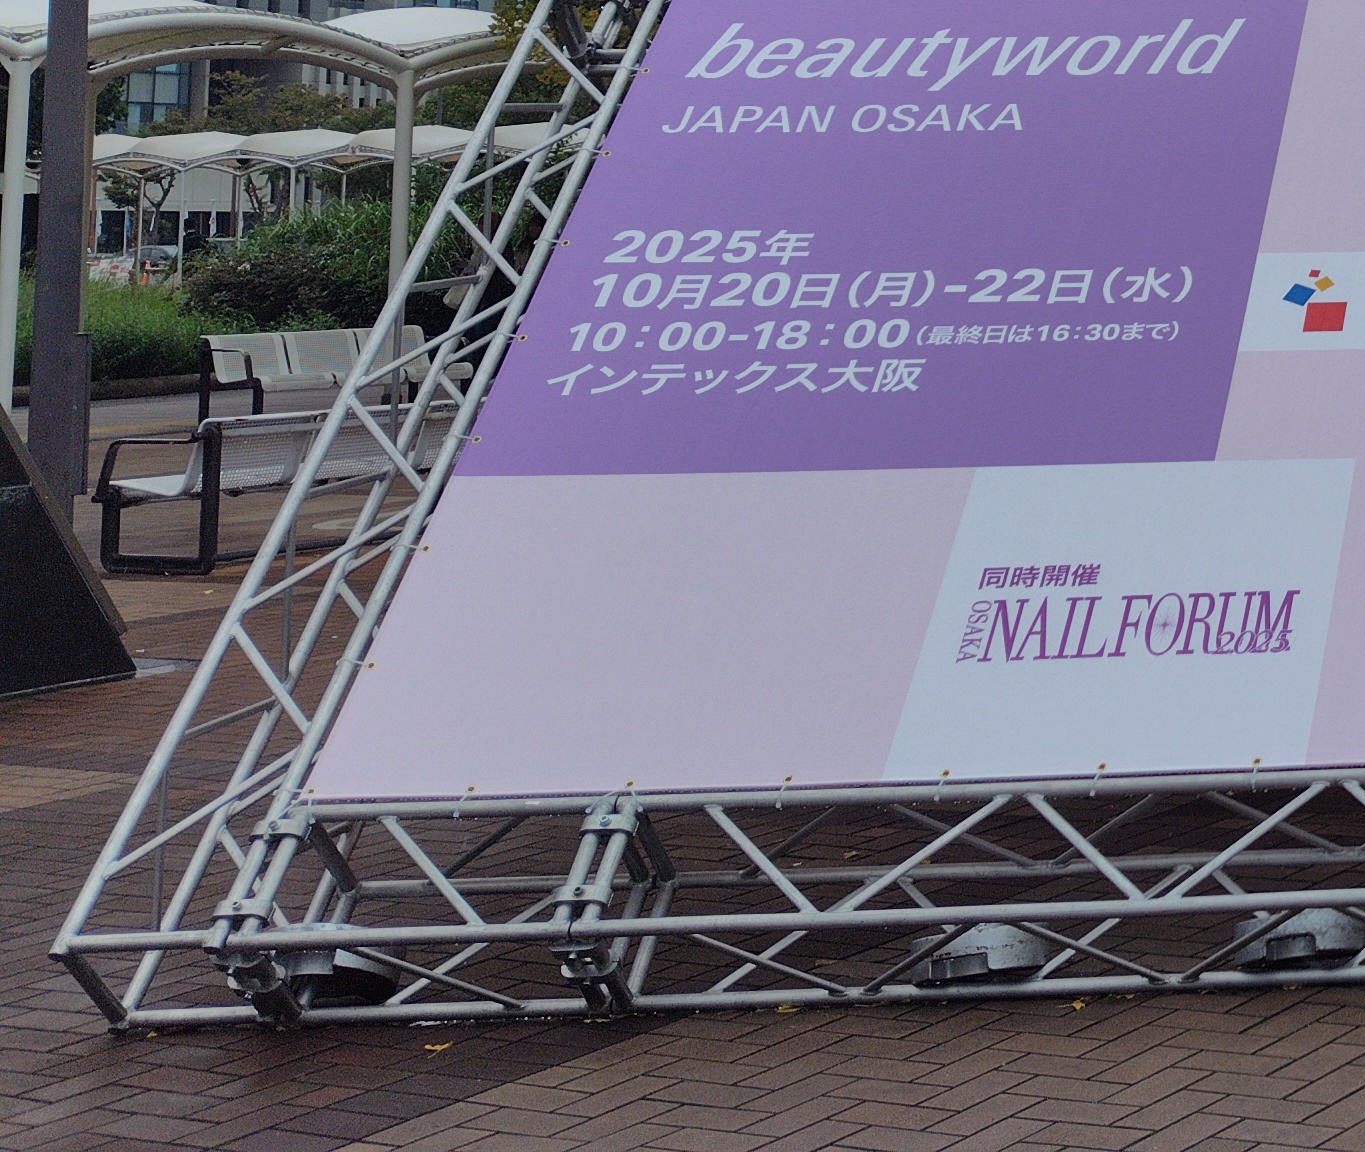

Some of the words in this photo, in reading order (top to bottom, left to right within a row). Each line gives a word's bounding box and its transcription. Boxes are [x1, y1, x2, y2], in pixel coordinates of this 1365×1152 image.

[685, 18, 1247, 92] beautyworld
[662, 105, 835, 134] JAPAN
[851, 103, 1023, 133] OSAKA
[602, 229, 815, 265] 2025年
[547, 358, 927, 396] インテックス大阪
[978, 563, 1102, 590] 同時開催
[955, 600, 992, 663] OSAKA
[977, 596, 1108, 662] NAIL
[1107, 589, 1301, 656] FORUM
[1212, 629, 1293, 654] 2025
